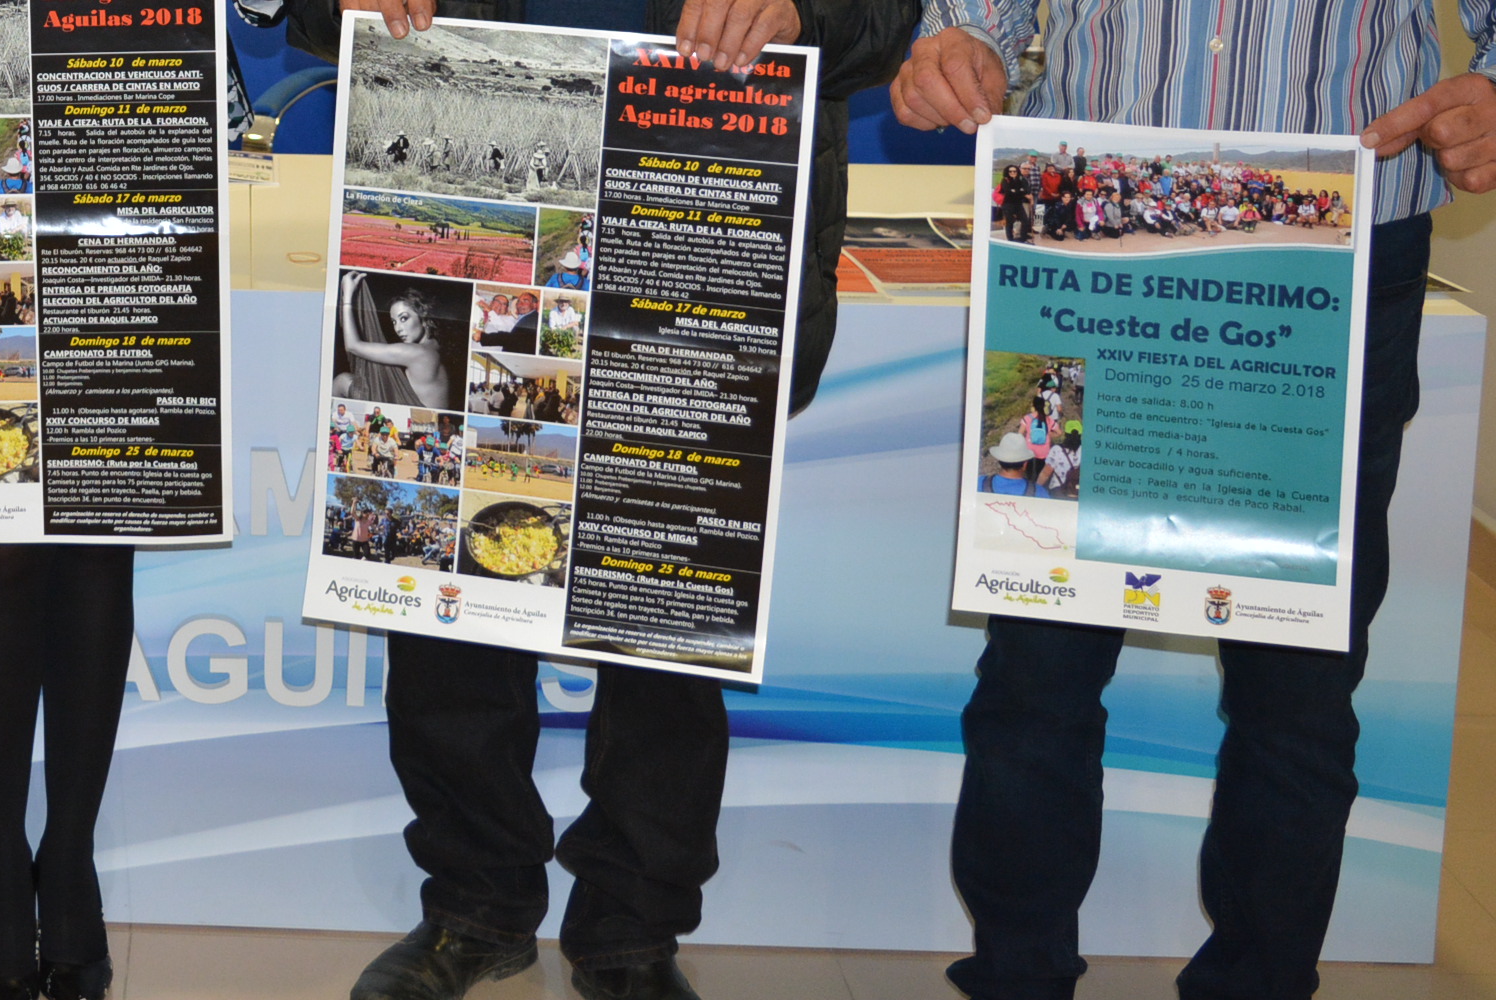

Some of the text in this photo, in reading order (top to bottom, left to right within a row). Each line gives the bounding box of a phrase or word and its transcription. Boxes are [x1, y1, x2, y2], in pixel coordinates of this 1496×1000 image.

[42, 7, 202, 31] Aguilas 2018
[66, 56, 183, 68] Sábado 10 de marzo
[617, 75, 792, 107] del agricultor
[63, 103, 187, 117] Domingo 11 de marzo
[618, 104, 787, 135] Aguilas 2018
[72, 192, 182, 204] Sábado 17 de marzo
[998, 263, 1340, 312] RUTA DE SENDERIMO:
[629, 297, 746, 319] Sábado 17 de marzo
[674, 316, 778, 334] MISA DEL AGRICULTOR
[1169, 317, 1209, 343] de
[630, 343, 656, 352] CENA
[657, 346, 669, 354] DE
[1096, 347, 1336, 379] XXIV FIESTA DEL AGRICULTOR
[1104, 367, 1325, 399] Domingo 25 de marzo 2.018
[1096, 391, 1214, 410] Hora de salida: 8.00 h
[45, 416, 159, 424] XXIV CONCURSO DE MIGAS
[583, 452, 698, 474] CAMPEONATO DE FUTBOL
[1093, 455, 1125, 467] Llevar
[1127, 459, 1175, 472] bocadillo
[1177, 465, 1184, 474] y
[1187, 466, 1214, 476] agua
[600, 555, 732, 582] Domingo 25 de marzo
[325, 579, 422, 608] Agricultores
[974, 572, 1076, 599] Agricultores
[1122, 609, 1159, 617] DEPORTIVO
[1122, 614, 1159, 622] MUNICIPAL
